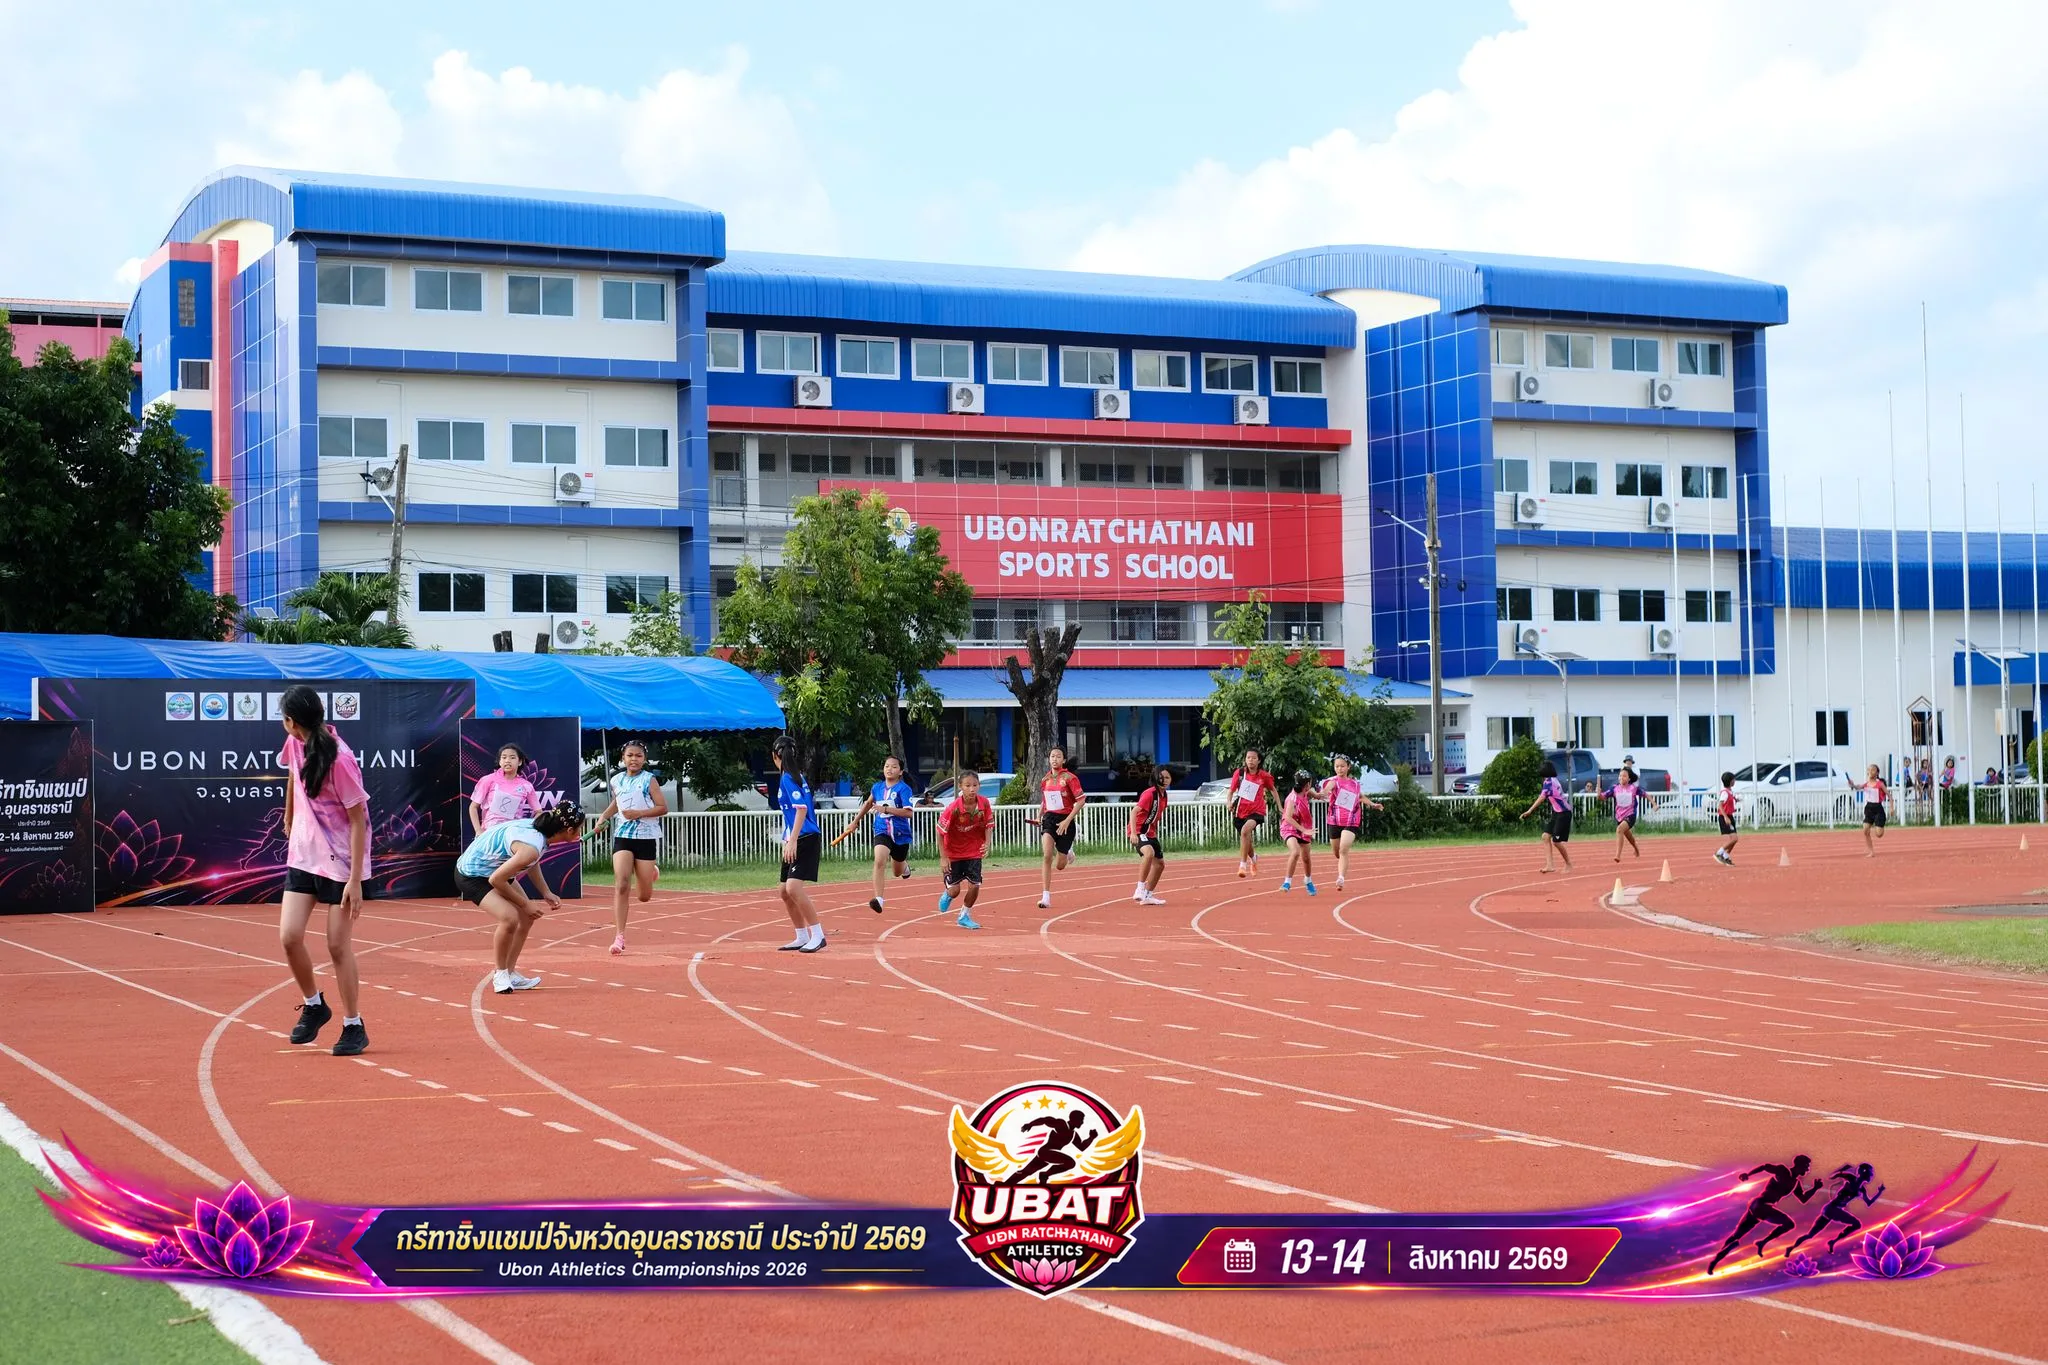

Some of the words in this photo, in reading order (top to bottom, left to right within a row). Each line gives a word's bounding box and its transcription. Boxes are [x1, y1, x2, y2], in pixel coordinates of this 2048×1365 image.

[964, 515, 1254, 546] UBONRATCHATHANI
[999, 551, 1109, 577] SPORTS
[1126, 553, 1233, 580] SCHOOL
[113, 750, 206, 770] UBON
[499, 797, 511, 813] 8
[54, 831, 74, 840] 2569
